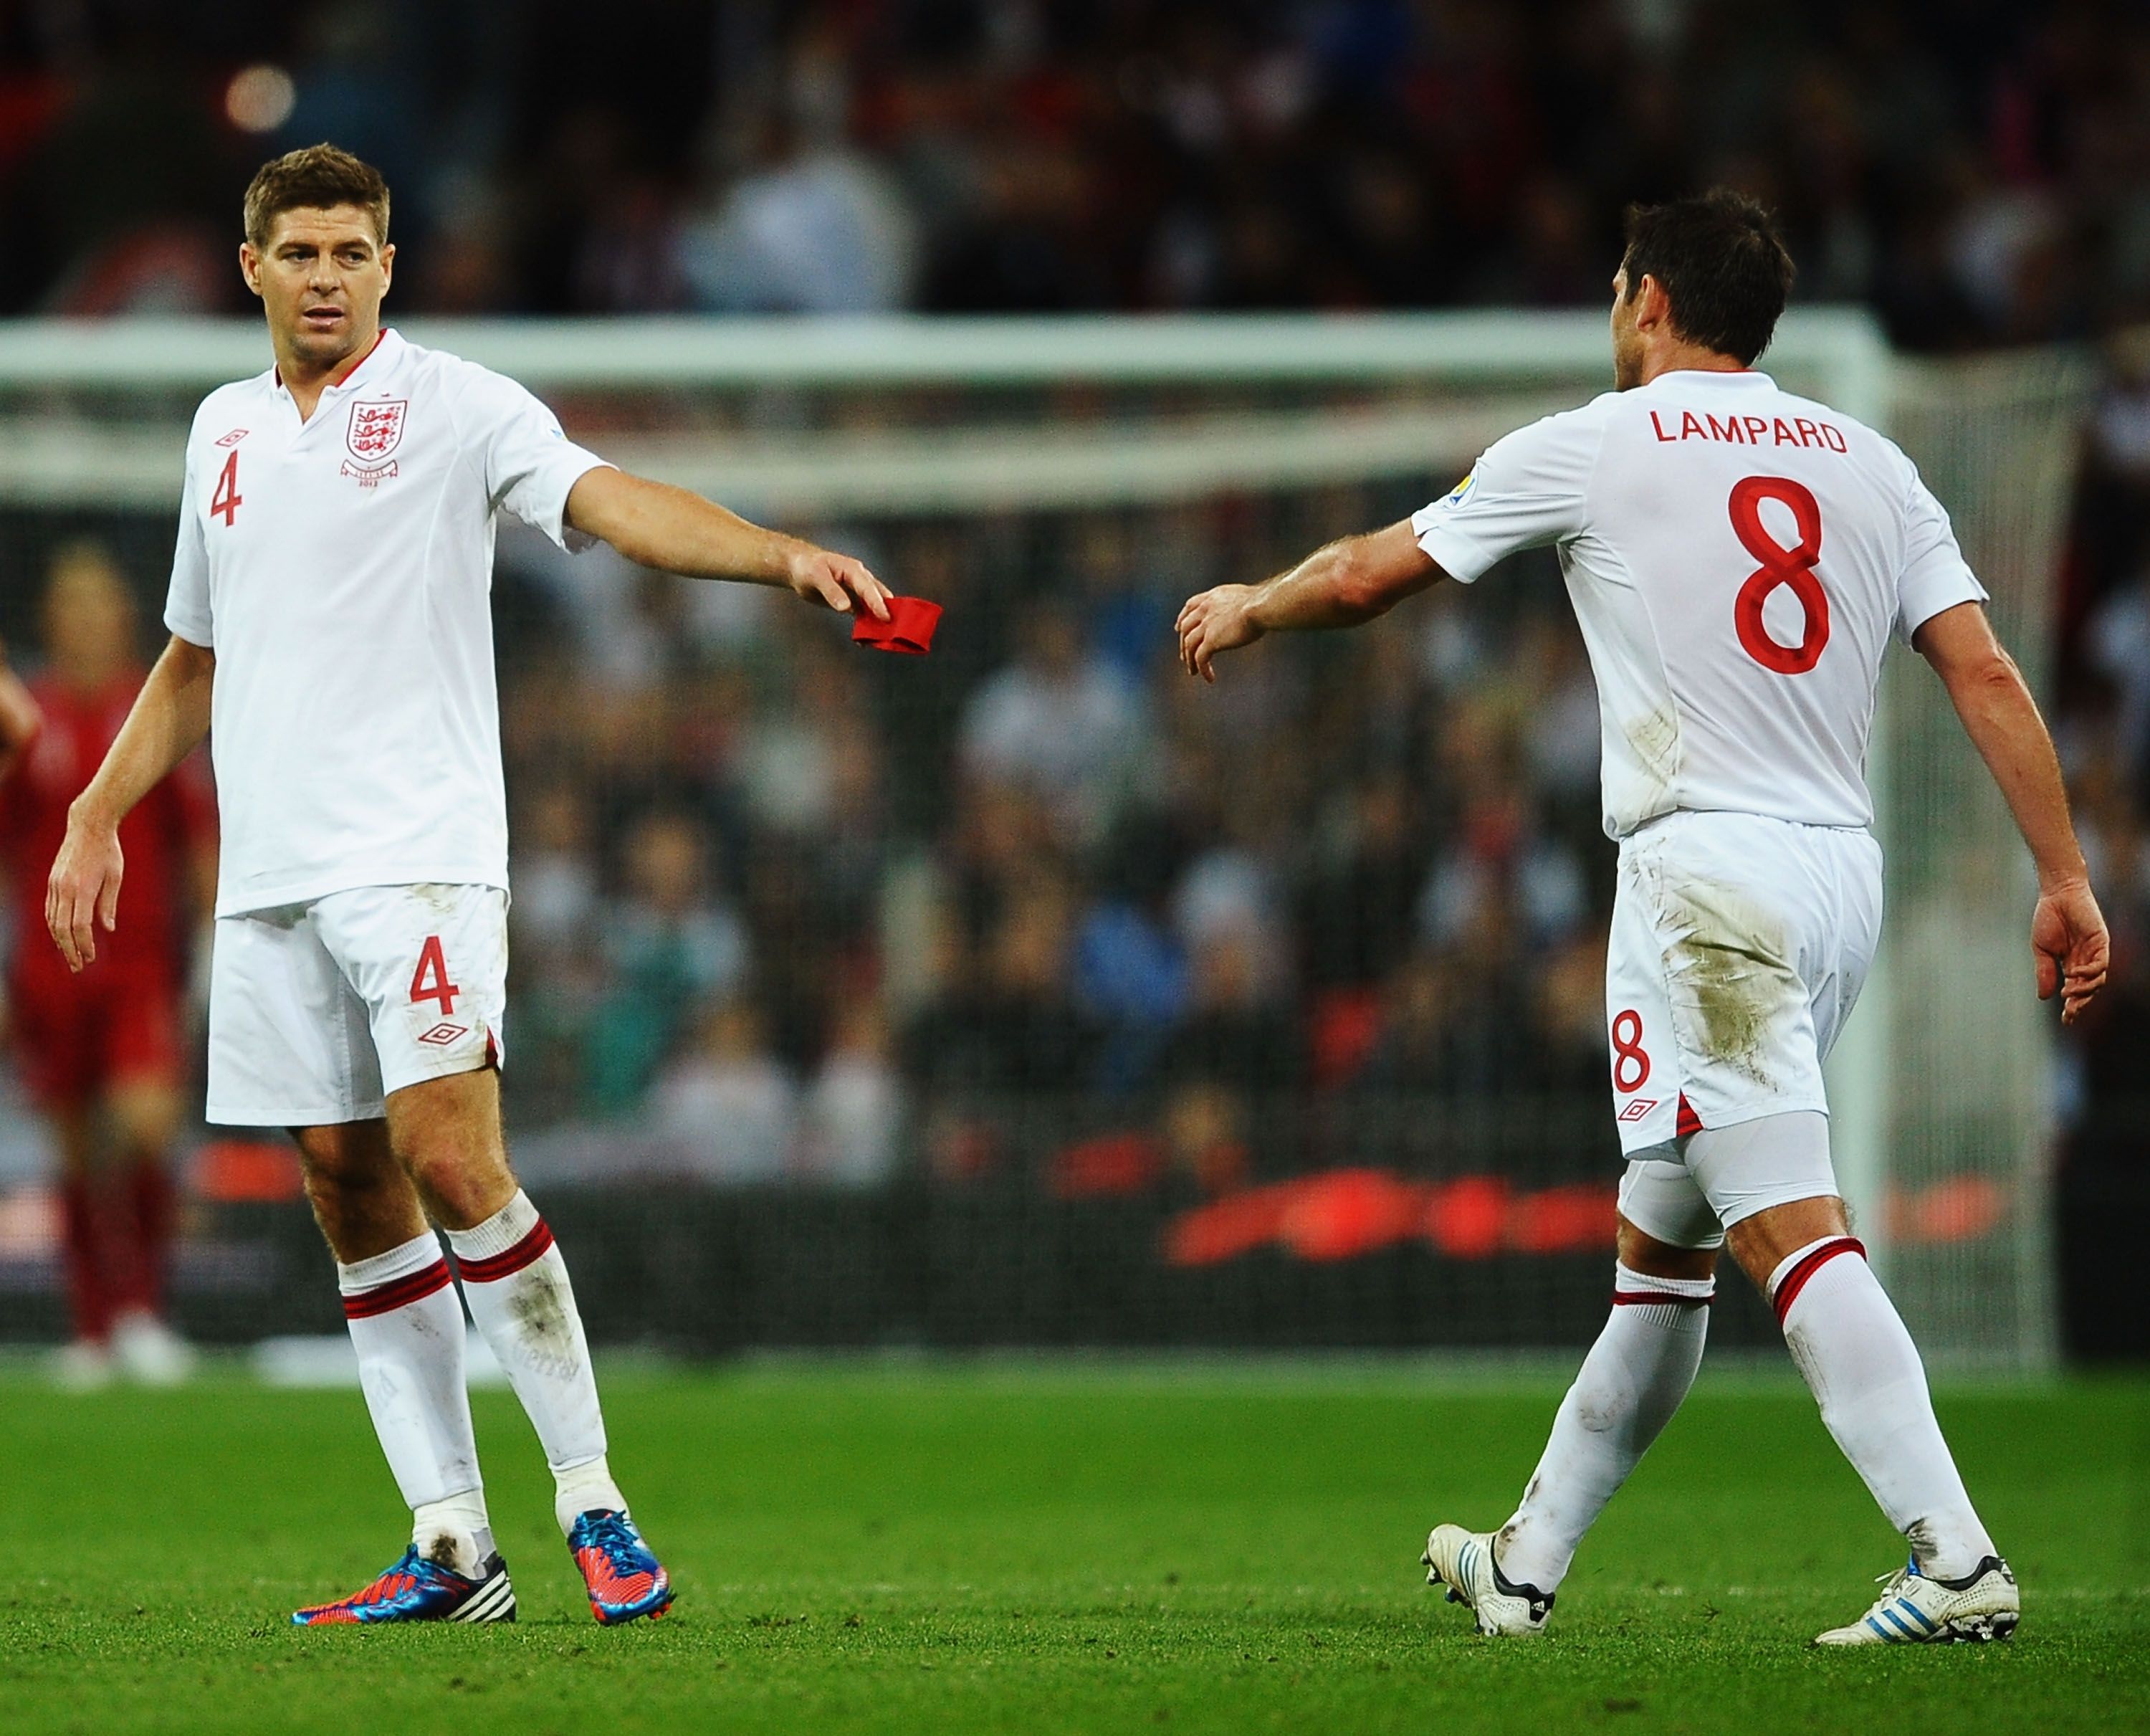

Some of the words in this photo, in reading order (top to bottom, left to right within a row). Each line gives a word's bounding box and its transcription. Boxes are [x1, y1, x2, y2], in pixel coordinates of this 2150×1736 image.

[1650, 411, 1847, 453] LAMPARD
[211, 449, 242, 527] 4
[1728, 476, 1830, 675] 8
[410, 936, 459, 1016] 4
[1612, 1009, 1650, 1093] 8
